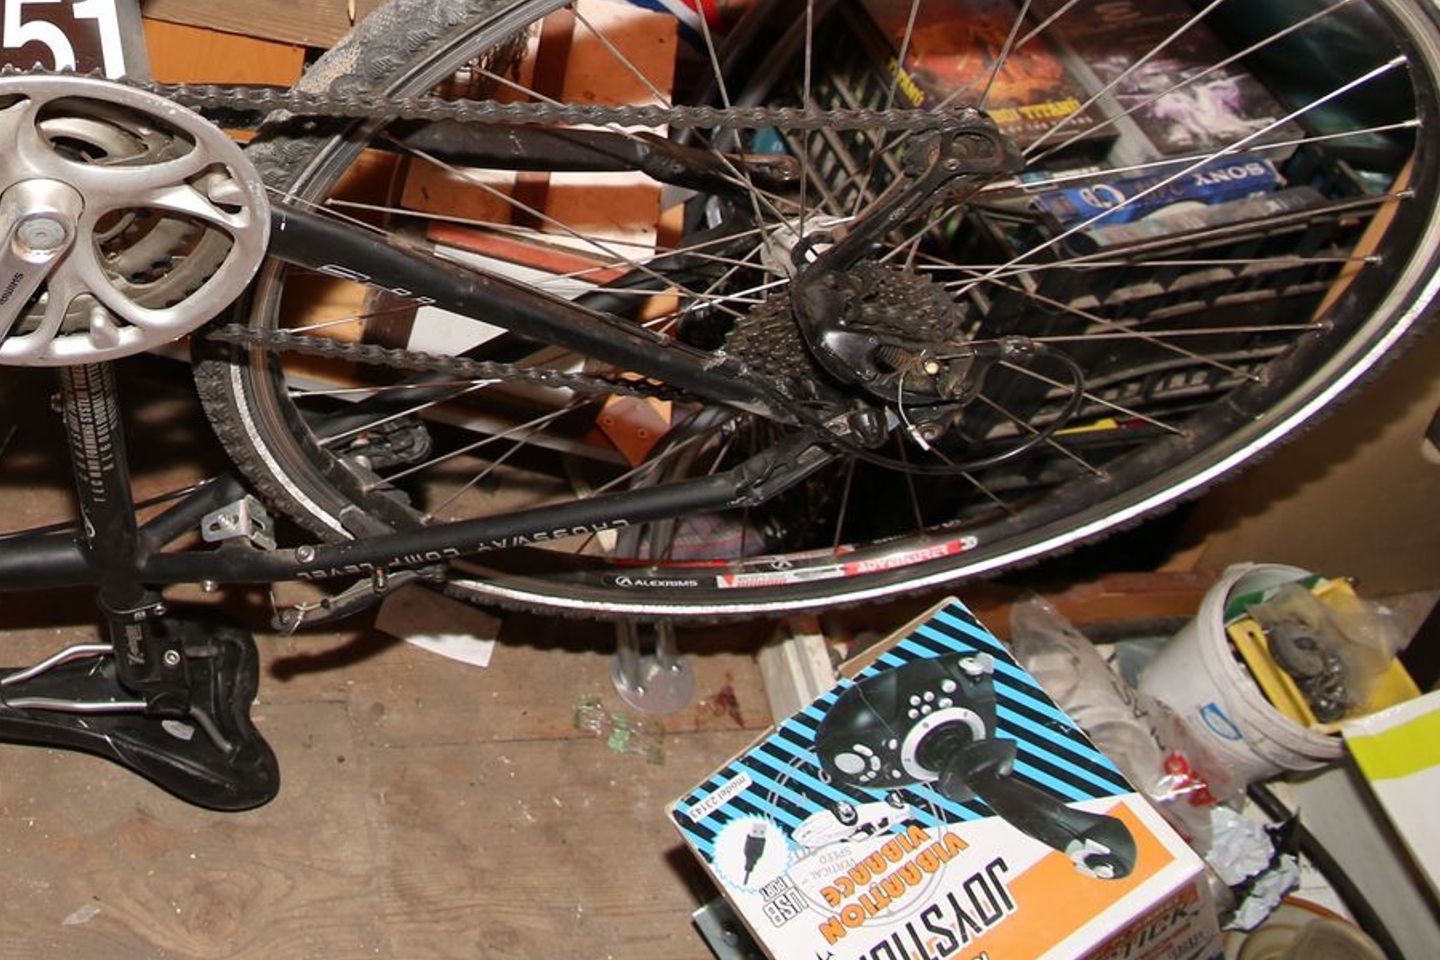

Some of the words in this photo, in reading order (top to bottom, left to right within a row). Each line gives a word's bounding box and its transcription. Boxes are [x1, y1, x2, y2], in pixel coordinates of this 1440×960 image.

[1193, 160, 1266, 187] SONY
[477, 518, 631, 553] CROSSWAY
[633, 578, 699, 588] ALEXRIMS
[716, 775, 747, 800] model
[690, 795, 718, 818] 23143
[818, 824, 931, 908] VIBRACE
[758, 876, 788, 902] PORT
[818, 831, 970, 946] VIBRATION
[761, 886, 808, 929] USB
[859, 856, 1015, 960] JOYSTI
